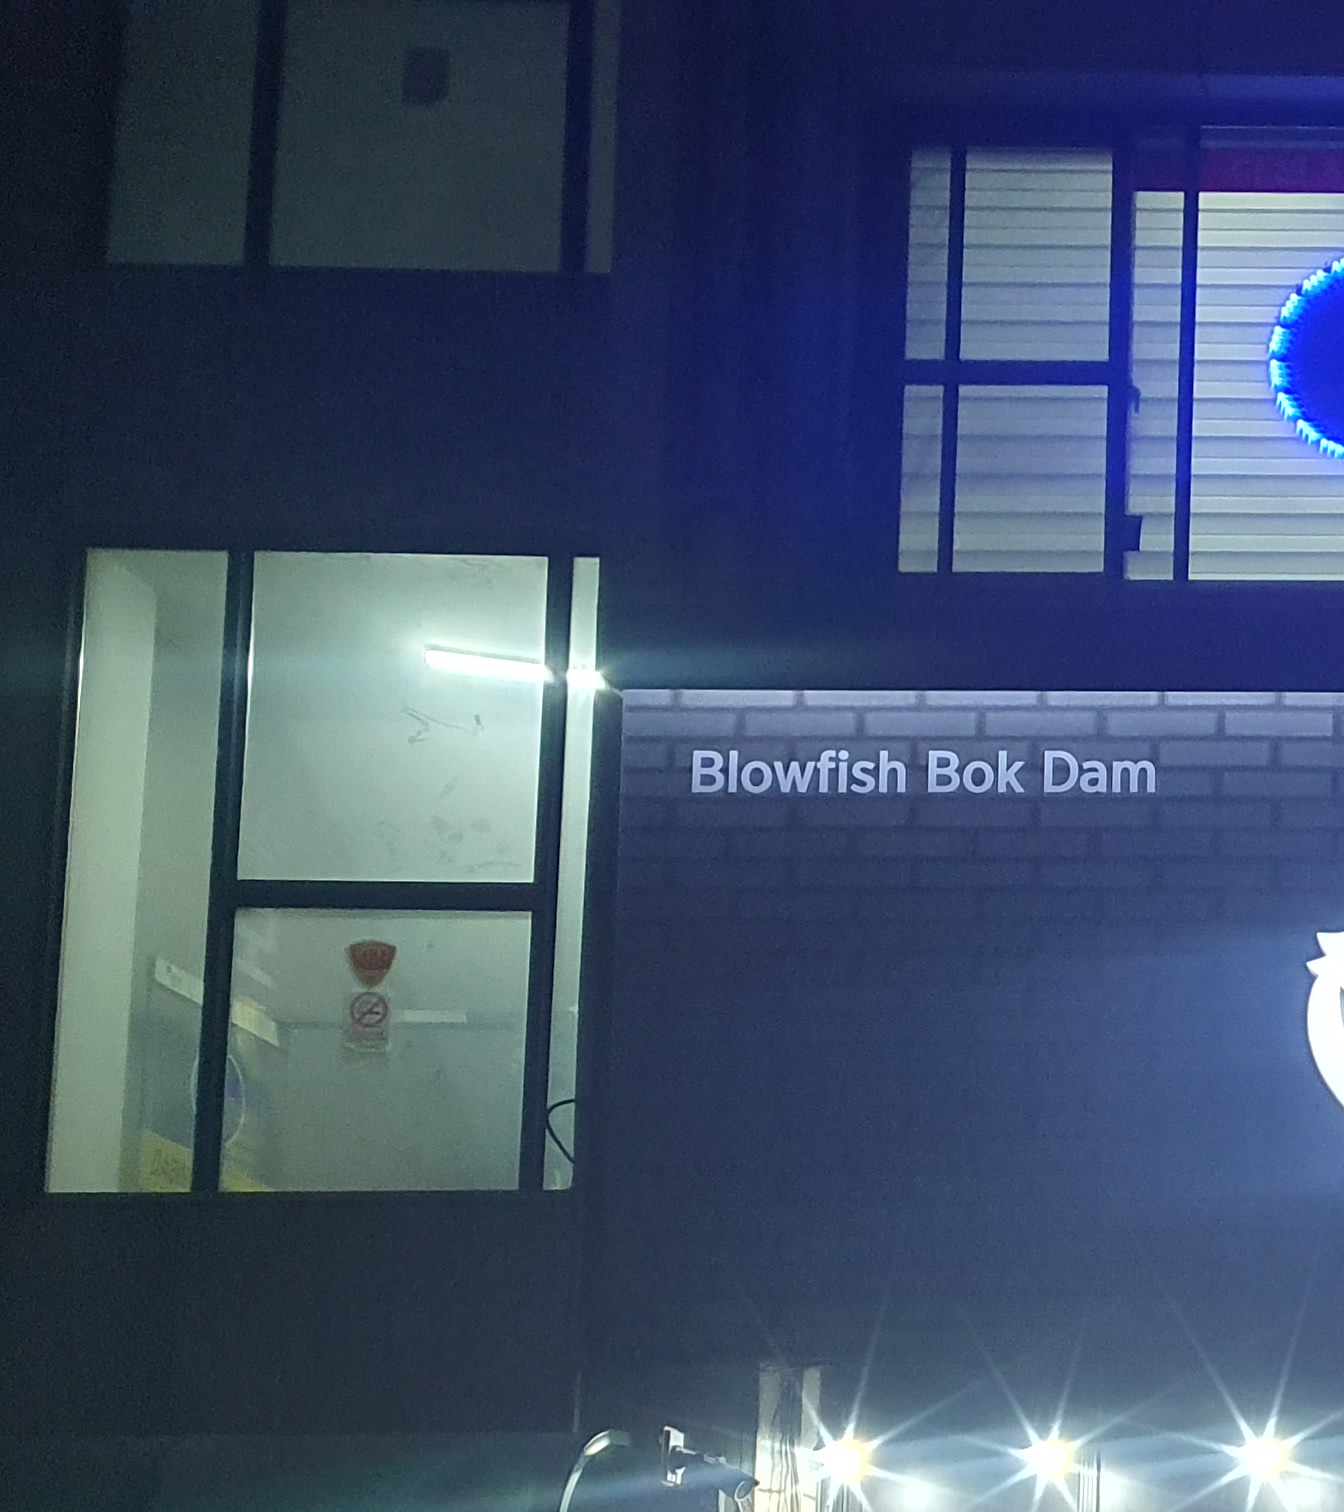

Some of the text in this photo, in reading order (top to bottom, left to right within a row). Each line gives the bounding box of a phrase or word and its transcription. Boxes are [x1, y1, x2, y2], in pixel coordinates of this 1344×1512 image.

[690, 750, 1157, 794] Blowfish Bok Dam
